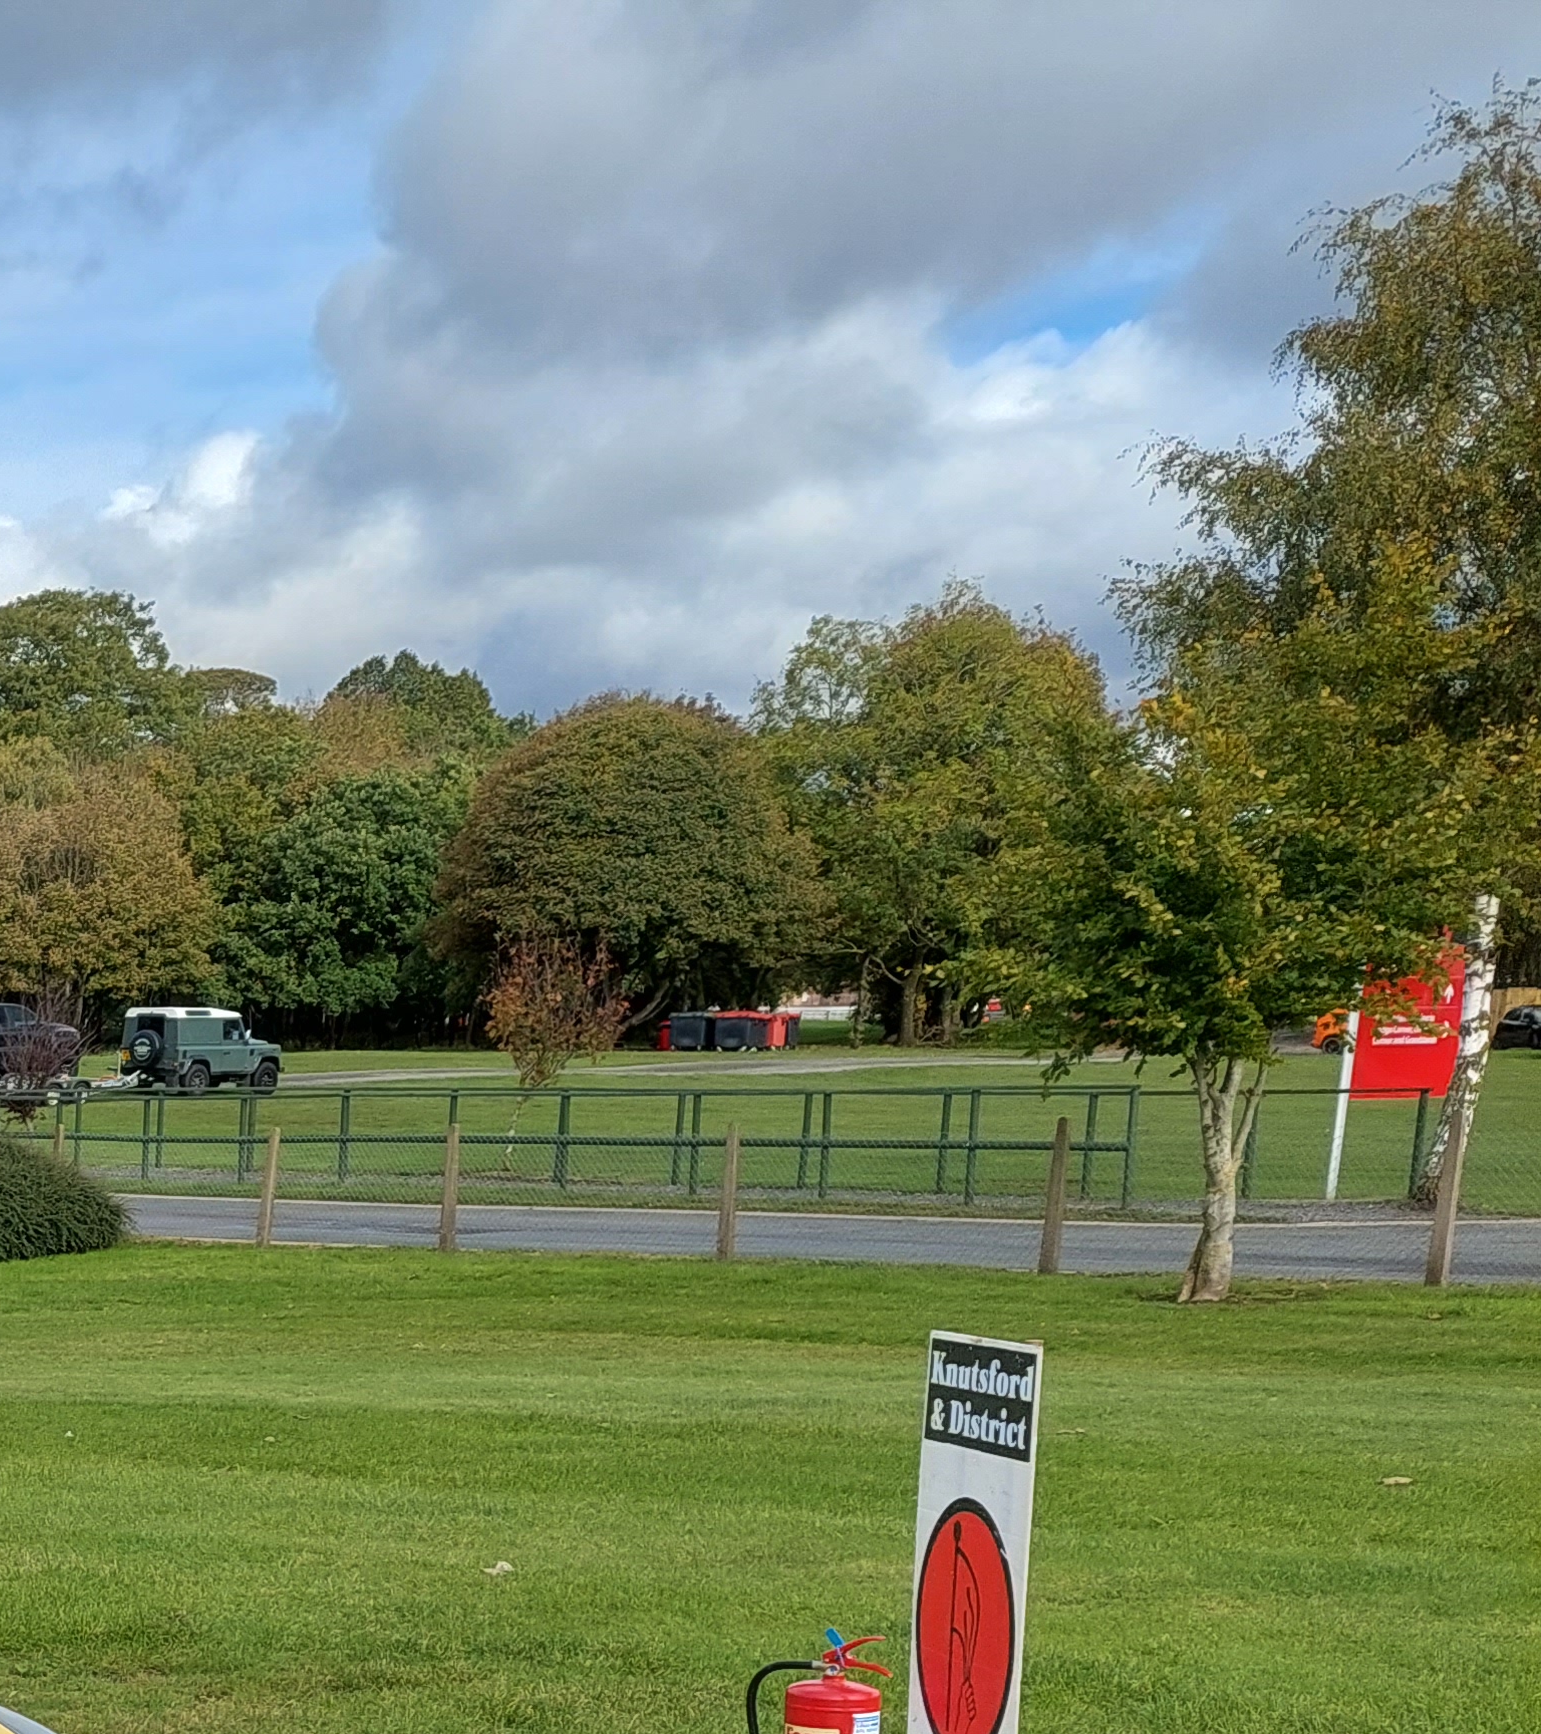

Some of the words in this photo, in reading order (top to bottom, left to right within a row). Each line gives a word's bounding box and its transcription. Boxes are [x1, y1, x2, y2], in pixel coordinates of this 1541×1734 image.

[931, 1351, 1035, 1402] Knutsford
[930, 1397, 946, 1431] &
[948, 1399, 1026, 1450] District
